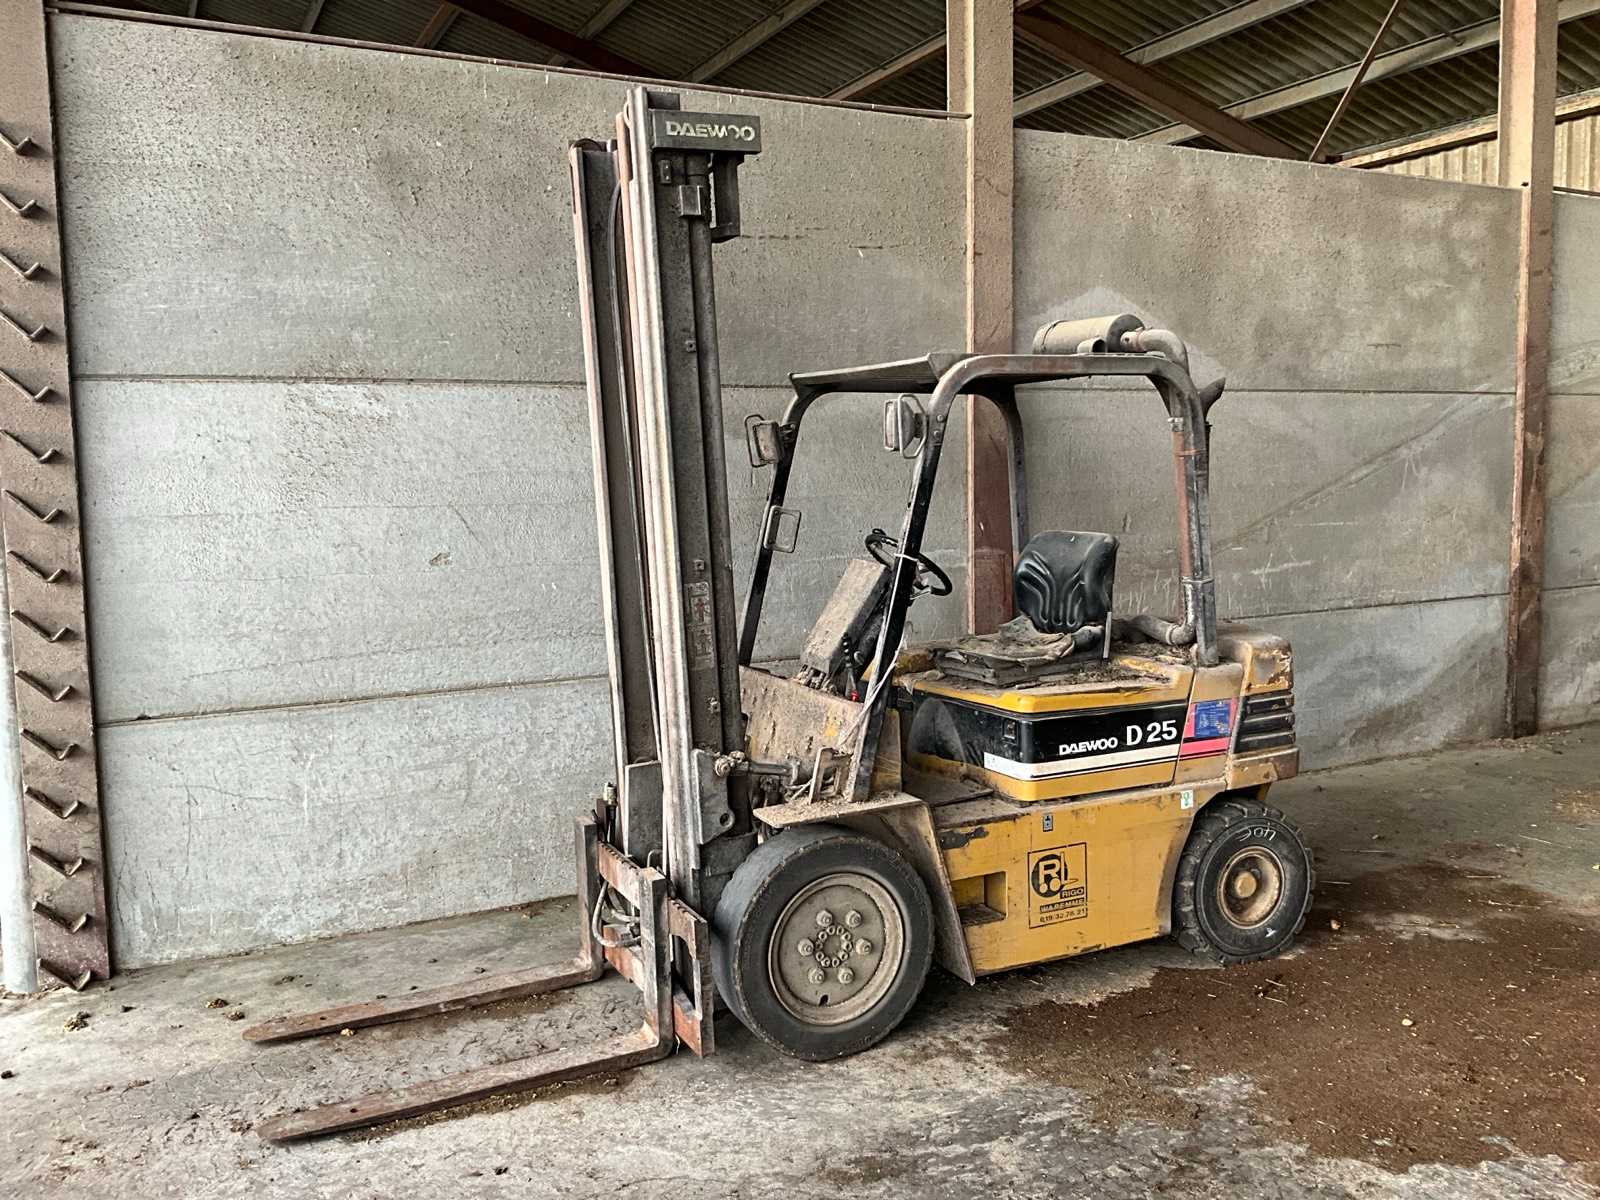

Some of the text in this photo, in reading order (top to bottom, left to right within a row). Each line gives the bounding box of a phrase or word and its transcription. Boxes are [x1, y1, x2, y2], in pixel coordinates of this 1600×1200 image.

[1058, 736, 1119, 756] DAEWOO
[1126, 724, 1143, 746] D
[1146, 719, 1178, 743] 25
[1061, 887, 1084, 899] RIGO
